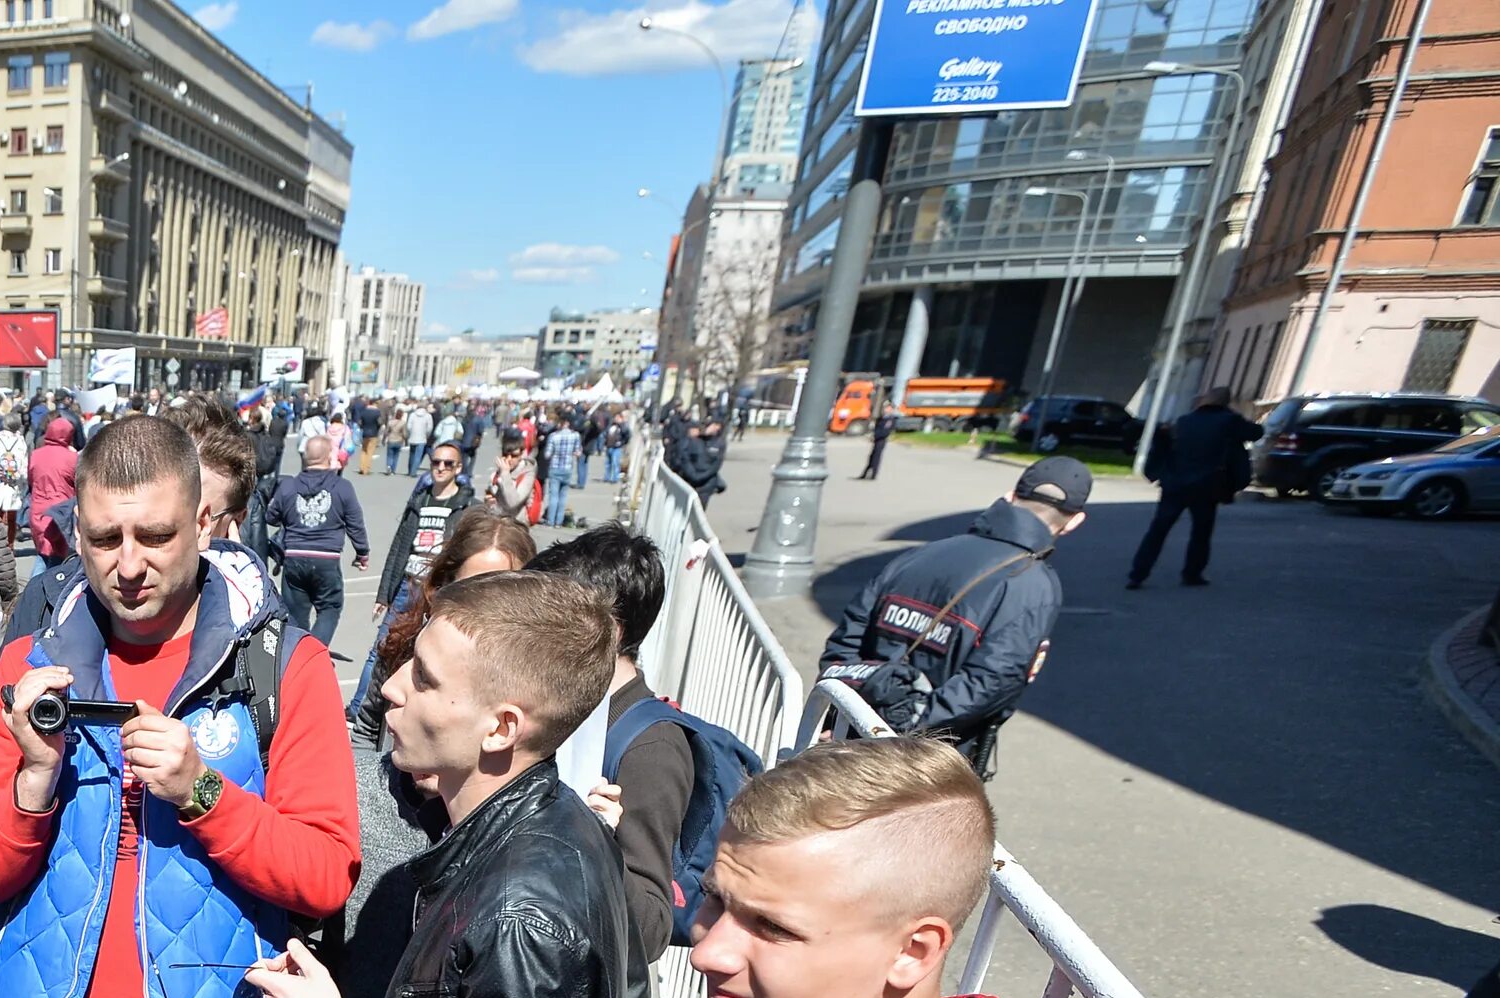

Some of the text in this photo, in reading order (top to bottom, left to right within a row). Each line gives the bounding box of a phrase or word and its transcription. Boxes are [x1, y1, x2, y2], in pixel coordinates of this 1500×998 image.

[934, 15, 1029, 35] СВОБОДНО
[938, 56, 1003, 81] Gallery
[931, 85, 999, 103] 225-2040
